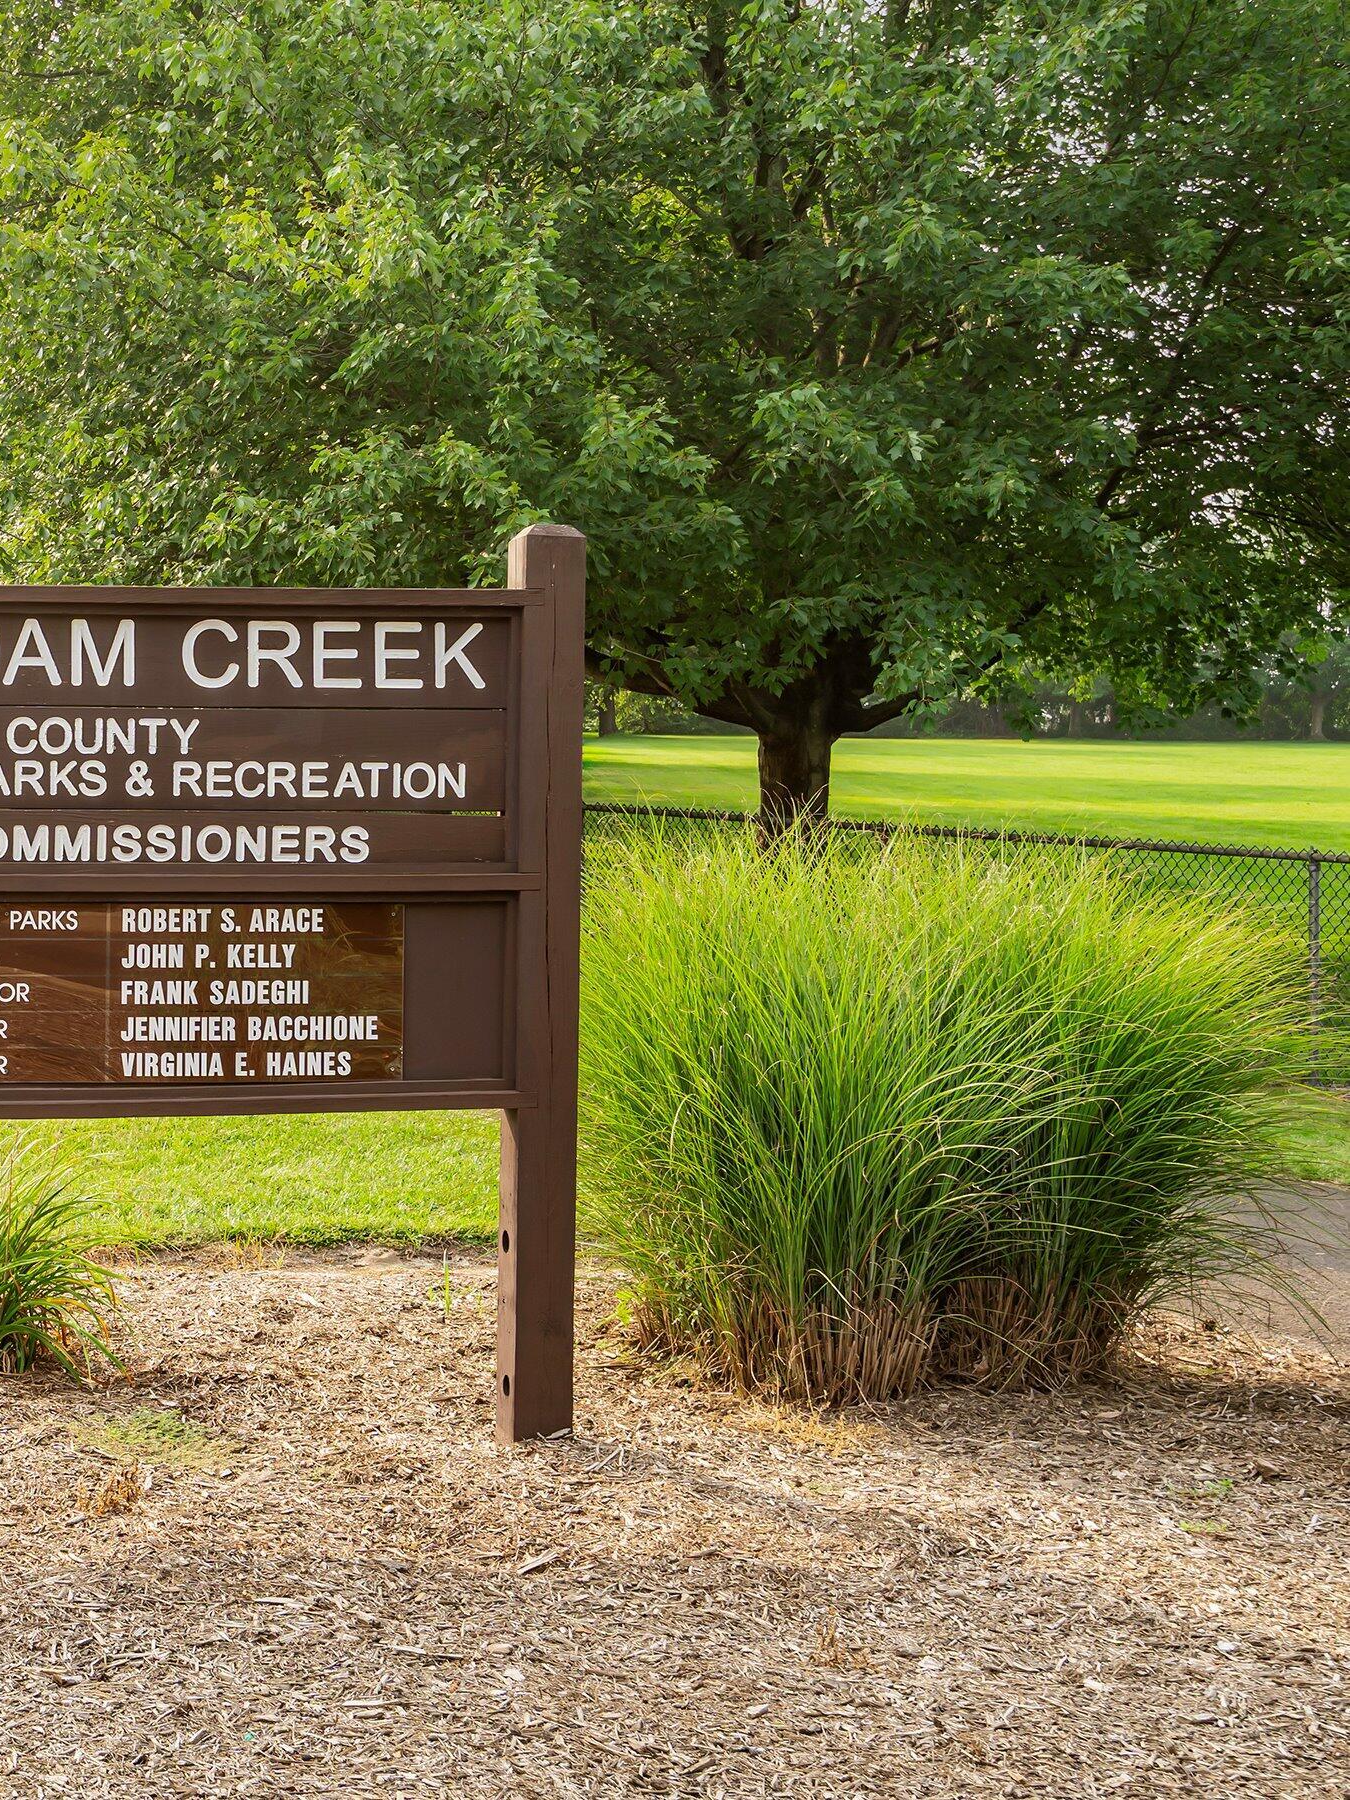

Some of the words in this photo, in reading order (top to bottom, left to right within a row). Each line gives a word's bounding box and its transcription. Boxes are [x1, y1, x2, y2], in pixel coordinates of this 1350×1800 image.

[181, 619, 486, 689] CREEK
[6, 716, 200, 755] COUNTY
[125, 760, 156, 796] &
[172, 761, 466, 798] RECREATION
[10, 910, 78, 931] PARKS
[122, 908, 212, 933] ROBERT
[220, 908, 241, 933] S.
[248, 908, 324, 933] ARACE
[121, 943, 184, 969] JOHN
[195, 944, 216, 969] P.
[227, 944, 296, 968] KELLY
[121, 980, 199, 1005] FRANK
[209, 980, 309, 1005] SADEGHI
[120, 1016, 236, 1042] JENNIFIER
[247, 1015, 379, 1041] BACCHIONE
[120, 1052, 224, 1077] VIRGINIA
[235, 1052, 255, 1077] E.
[266, 1051, 351, 1076] HAINES
